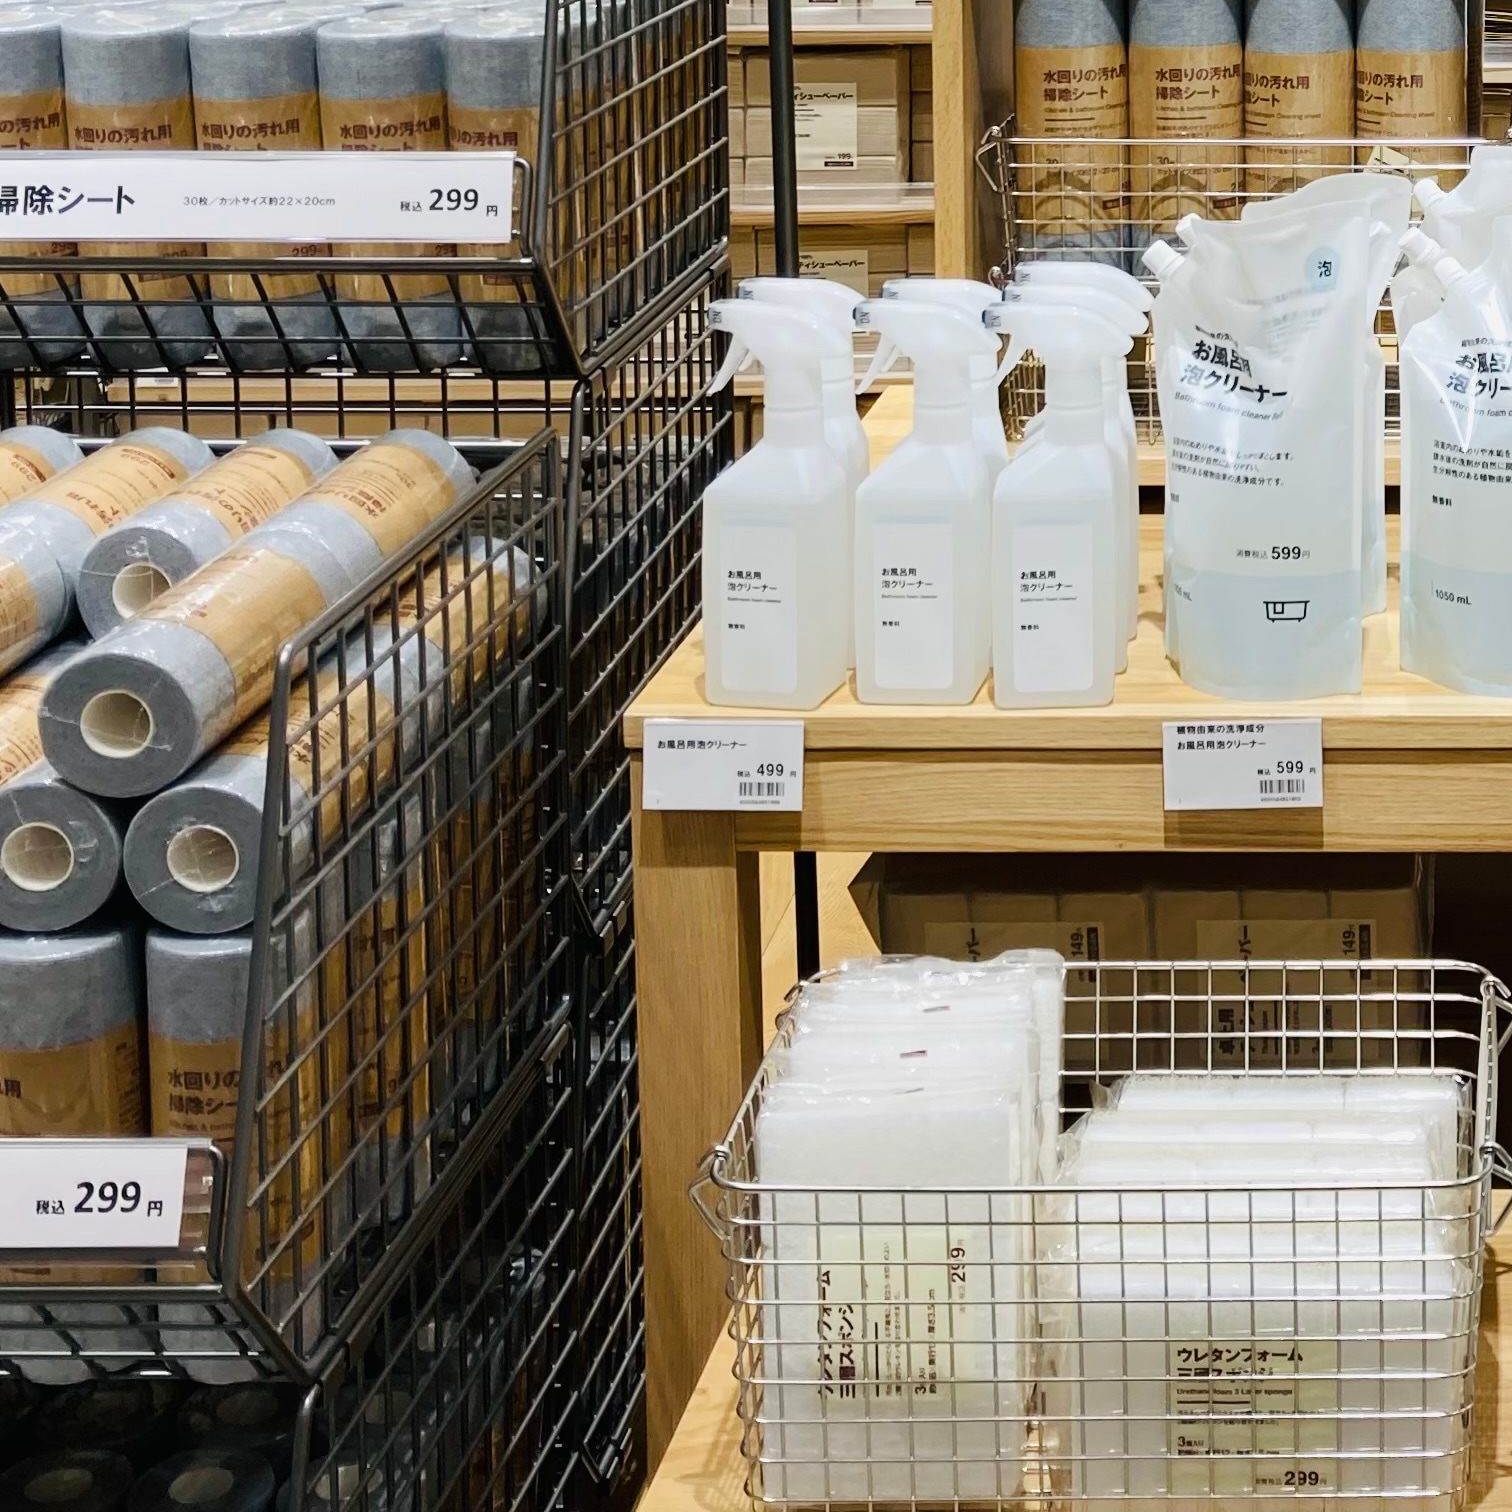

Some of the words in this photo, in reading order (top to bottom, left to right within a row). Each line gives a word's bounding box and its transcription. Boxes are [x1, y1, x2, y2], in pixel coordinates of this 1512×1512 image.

[1044, 86, 1108, 101] 掃除シート
[1156, 85, 1220, 100] 掃除シート
[75, 124, 171, 144] 水回りの汚れ用
[202, 118, 300, 140] 水回りの汚れ用
[340, 116, 440, 139] 水回りの汚れ用
[400, 201, 422, 212] 税込
[429, 188, 479, 212] 299
[486, 205, 498, 217] 円
[1318, 260, 1332, 278] 泡
[1180, 363, 1287, 403] 泡クリーナー
[1487, 408, 1506, 416] foam
[1236, 549, 1267, 559] 消費税込
[728, 571, 761, 580] お風呂用
[882, 568, 916, 576] お風呂用
[1021, 571, 1056, 579] お風呂用
[1436, 589, 1454, 602] 1050
[1457, 595, 1471, 605] mL
[1177, 724, 1264, 734] 植物由来の洗浄成分
[658, 740, 747, 749] お風呂用泡クリーナー
[1177, 740, 1265, 750] お風呂用泡クリーナー
[757, 763, 784, 776] 499
[1277, 761, 1304, 774] 599
[1342, 931, 1356, 955] 149
[36, 1200, 64, 1214] 税込
[74, 1181, 141, 1213] 299
[147, 1201, 162, 1216] 円
[1177, 1348, 1303, 1362] ウレタンフォーム
